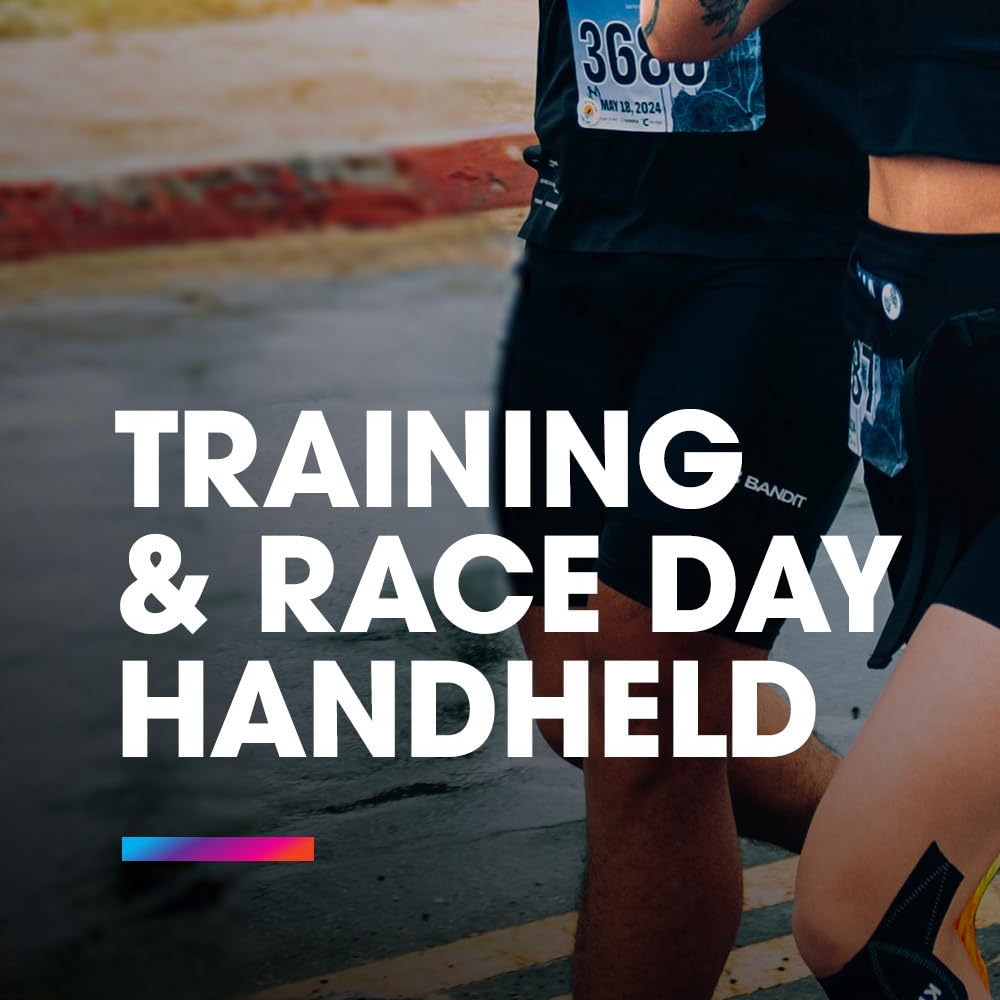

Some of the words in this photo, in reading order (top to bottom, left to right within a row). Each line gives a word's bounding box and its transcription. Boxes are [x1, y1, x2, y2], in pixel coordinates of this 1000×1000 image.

[601, 100, 618, 112] MAY
[620, 101, 634, 115] 18,
[635, 101, 662, 114] 2024
[744, 475, 808, 508] BANDIT
